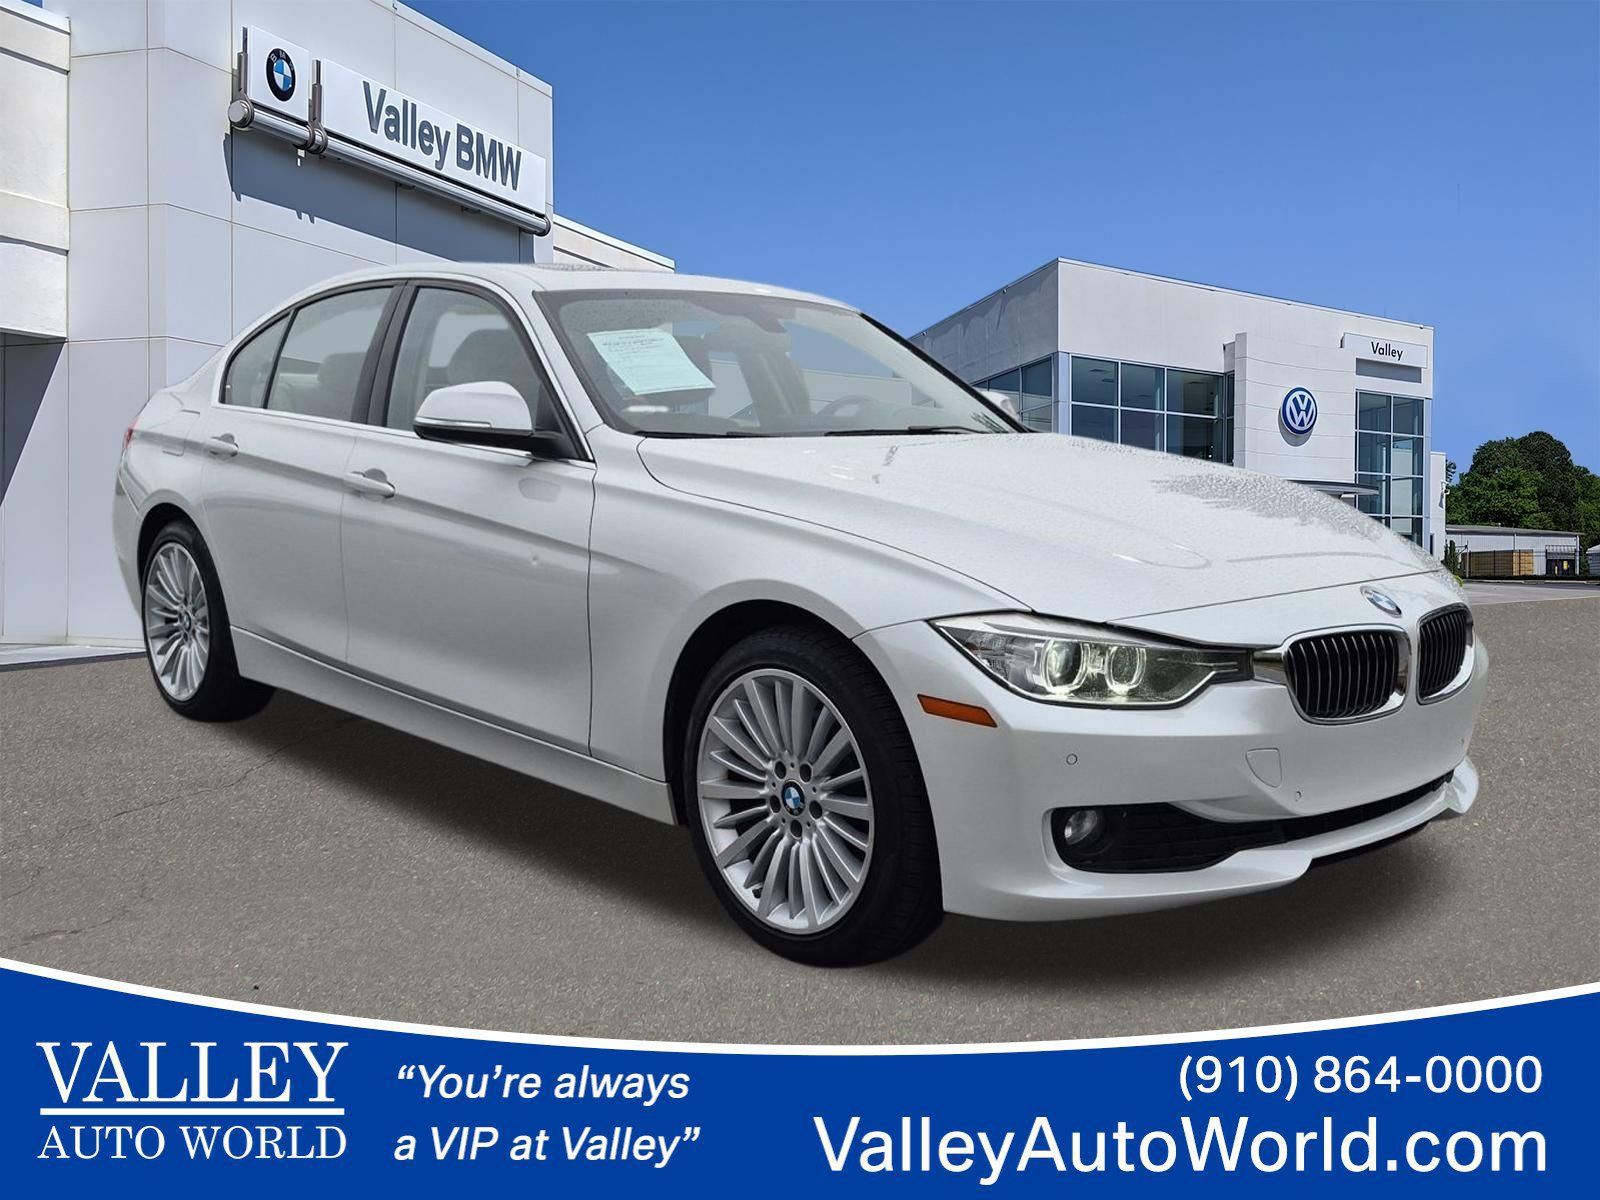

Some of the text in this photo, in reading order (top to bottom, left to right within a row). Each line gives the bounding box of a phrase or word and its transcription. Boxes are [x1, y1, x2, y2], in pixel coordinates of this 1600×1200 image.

[362, 81, 521, 190] Valley BMW
[1371, 341, 1403, 361] Valley
